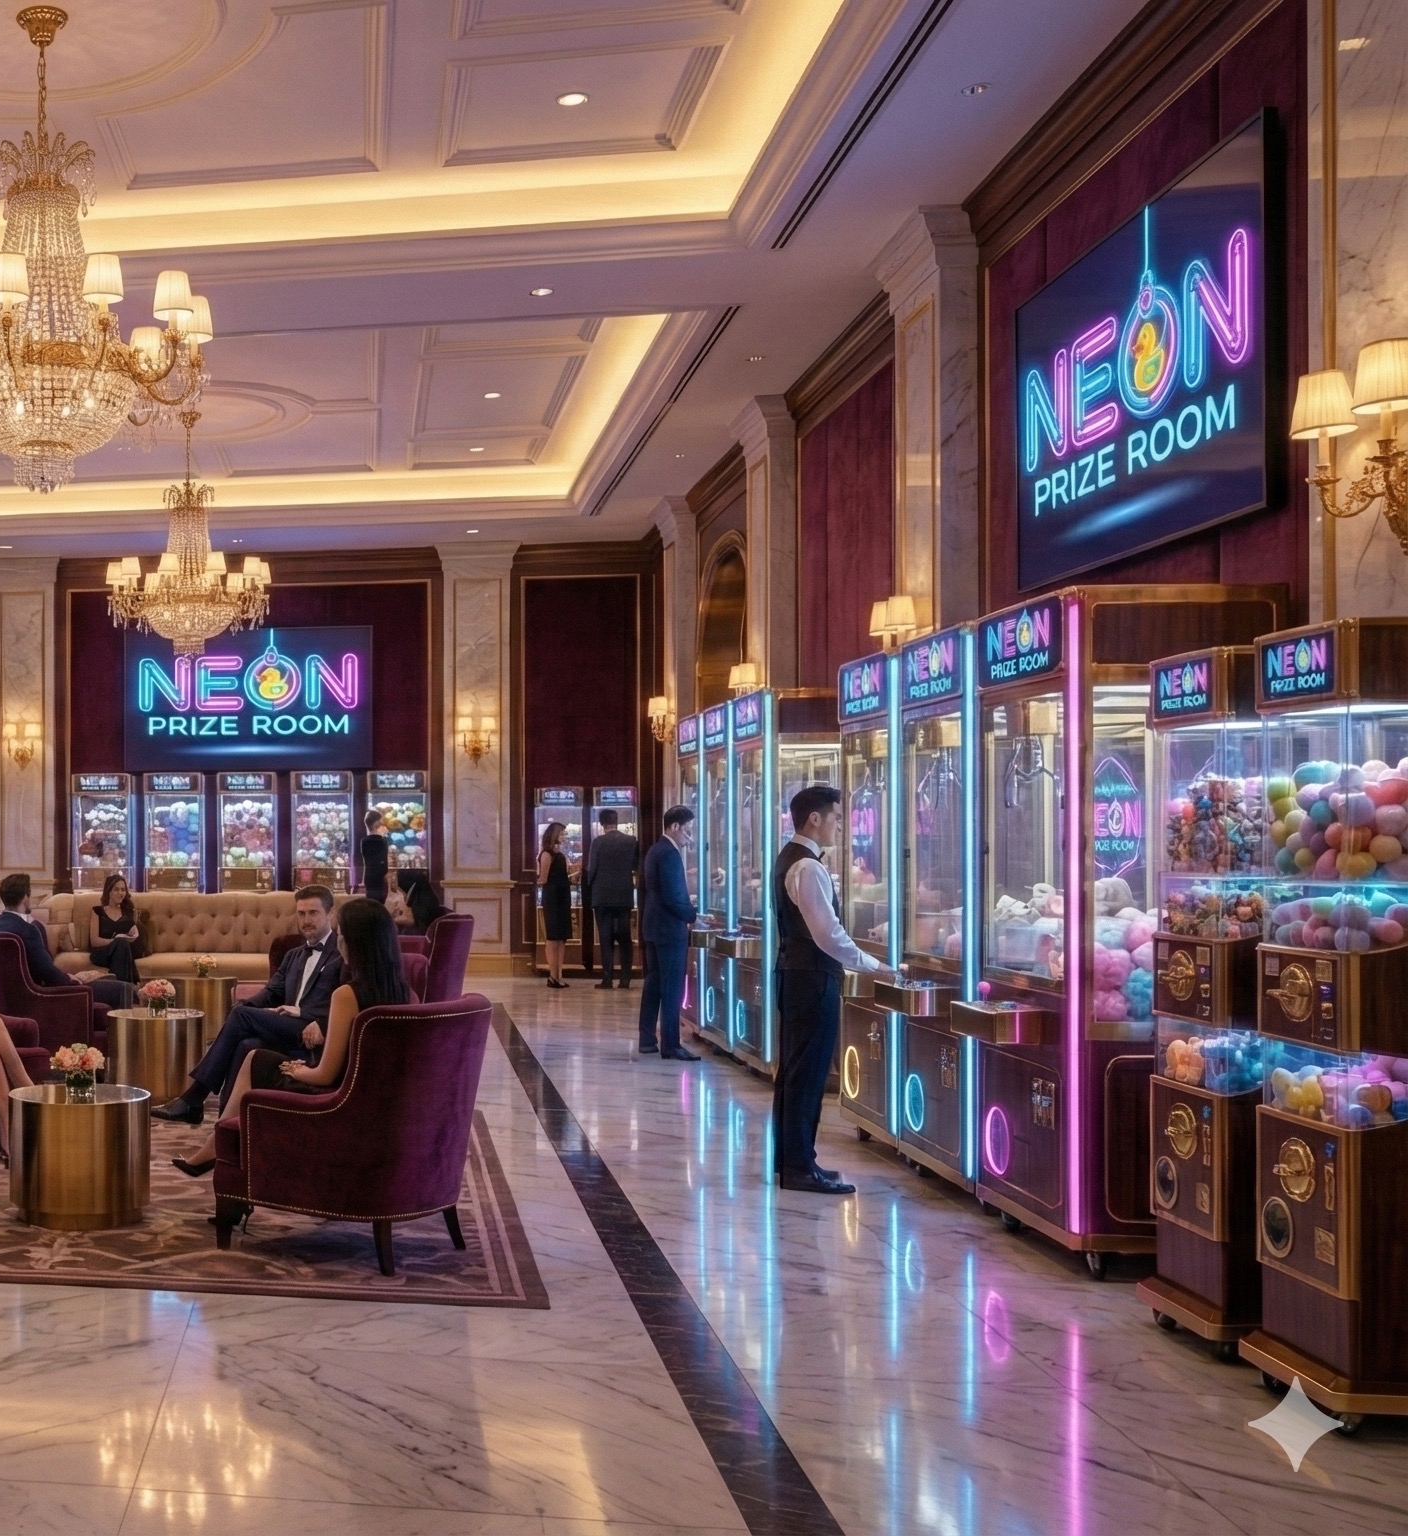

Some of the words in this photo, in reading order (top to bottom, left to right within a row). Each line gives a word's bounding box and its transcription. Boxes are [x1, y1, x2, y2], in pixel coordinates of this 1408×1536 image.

[1026, 228, 1249, 473] NEON
[1034, 443, 1117, 517] PRIZE
[1127, 384, 1236, 475] ROOM
[986, 607, 1050, 662] NEON
[1267, 637, 1327, 679] NEON
[138, 653, 359, 712] NEON
[1159, 662, 1208, 699] NEON
[148, 716, 240, 736] PRIZE
[252, 714, 350, 735] ROOM
[1094, 800, 1142, 838] EON
